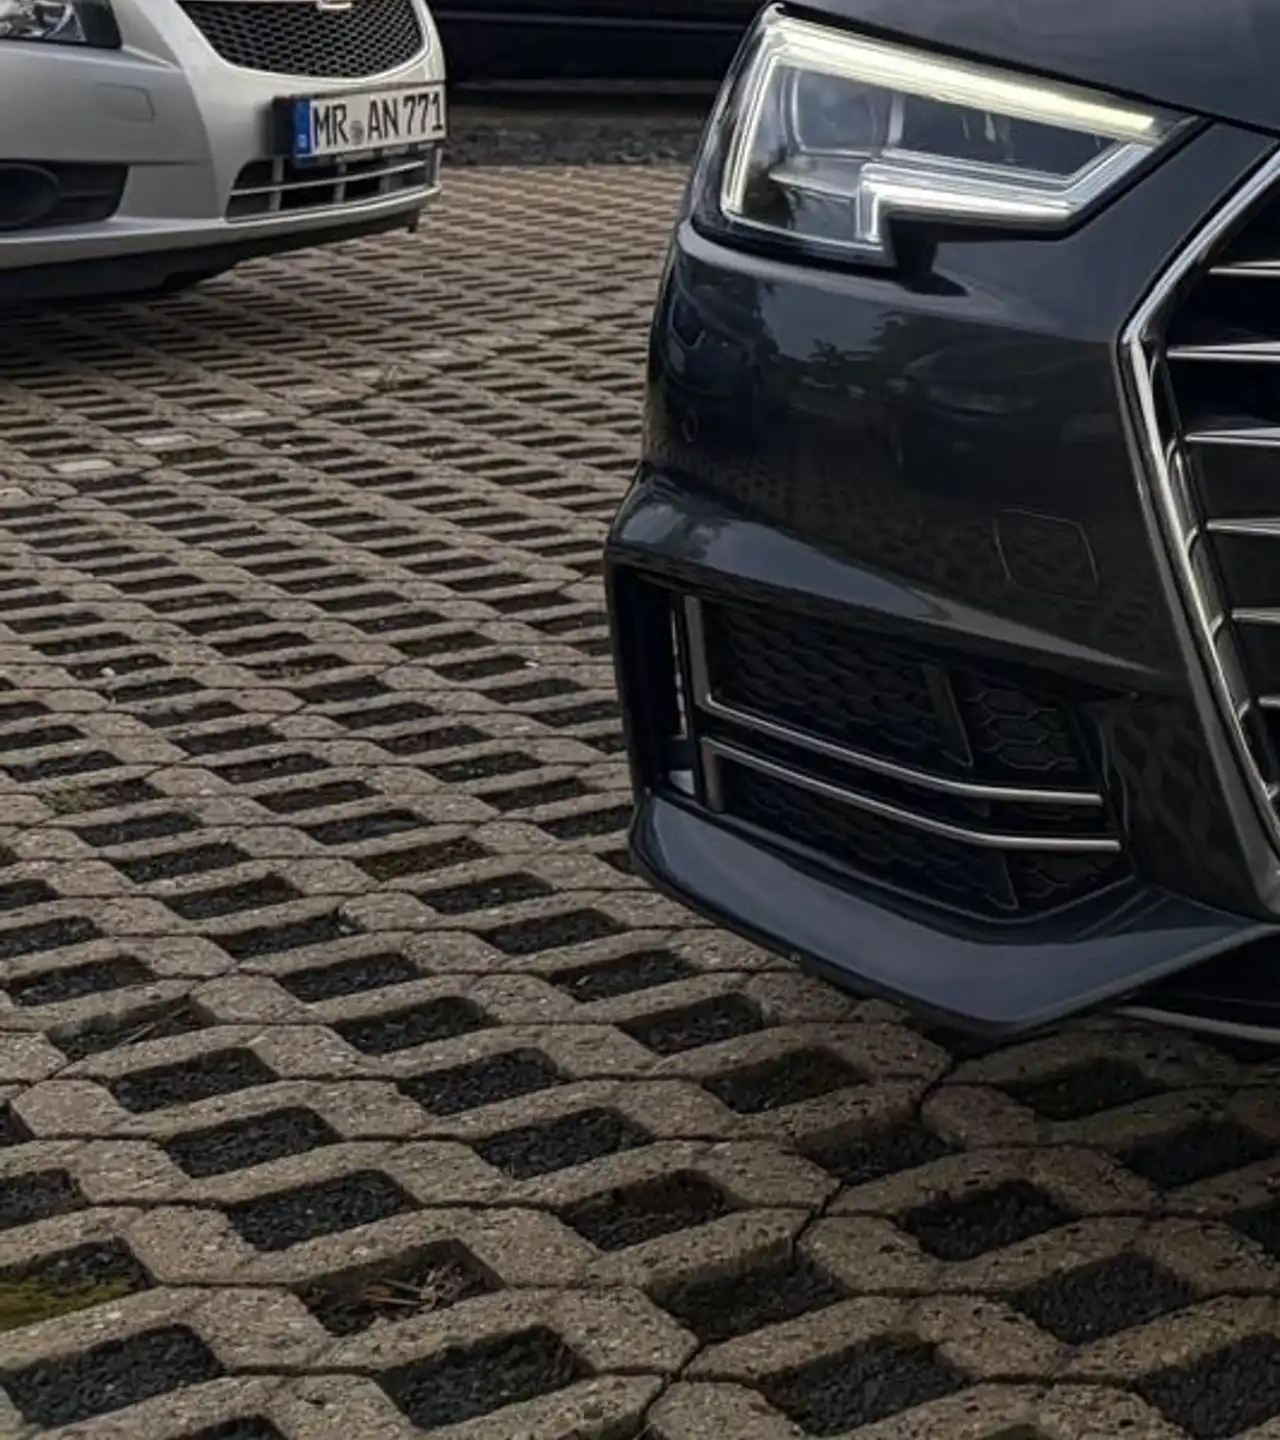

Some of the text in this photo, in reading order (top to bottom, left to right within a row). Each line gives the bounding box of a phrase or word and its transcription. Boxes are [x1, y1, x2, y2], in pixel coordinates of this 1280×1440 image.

[312, 91, 443, 147] MR AN 771
